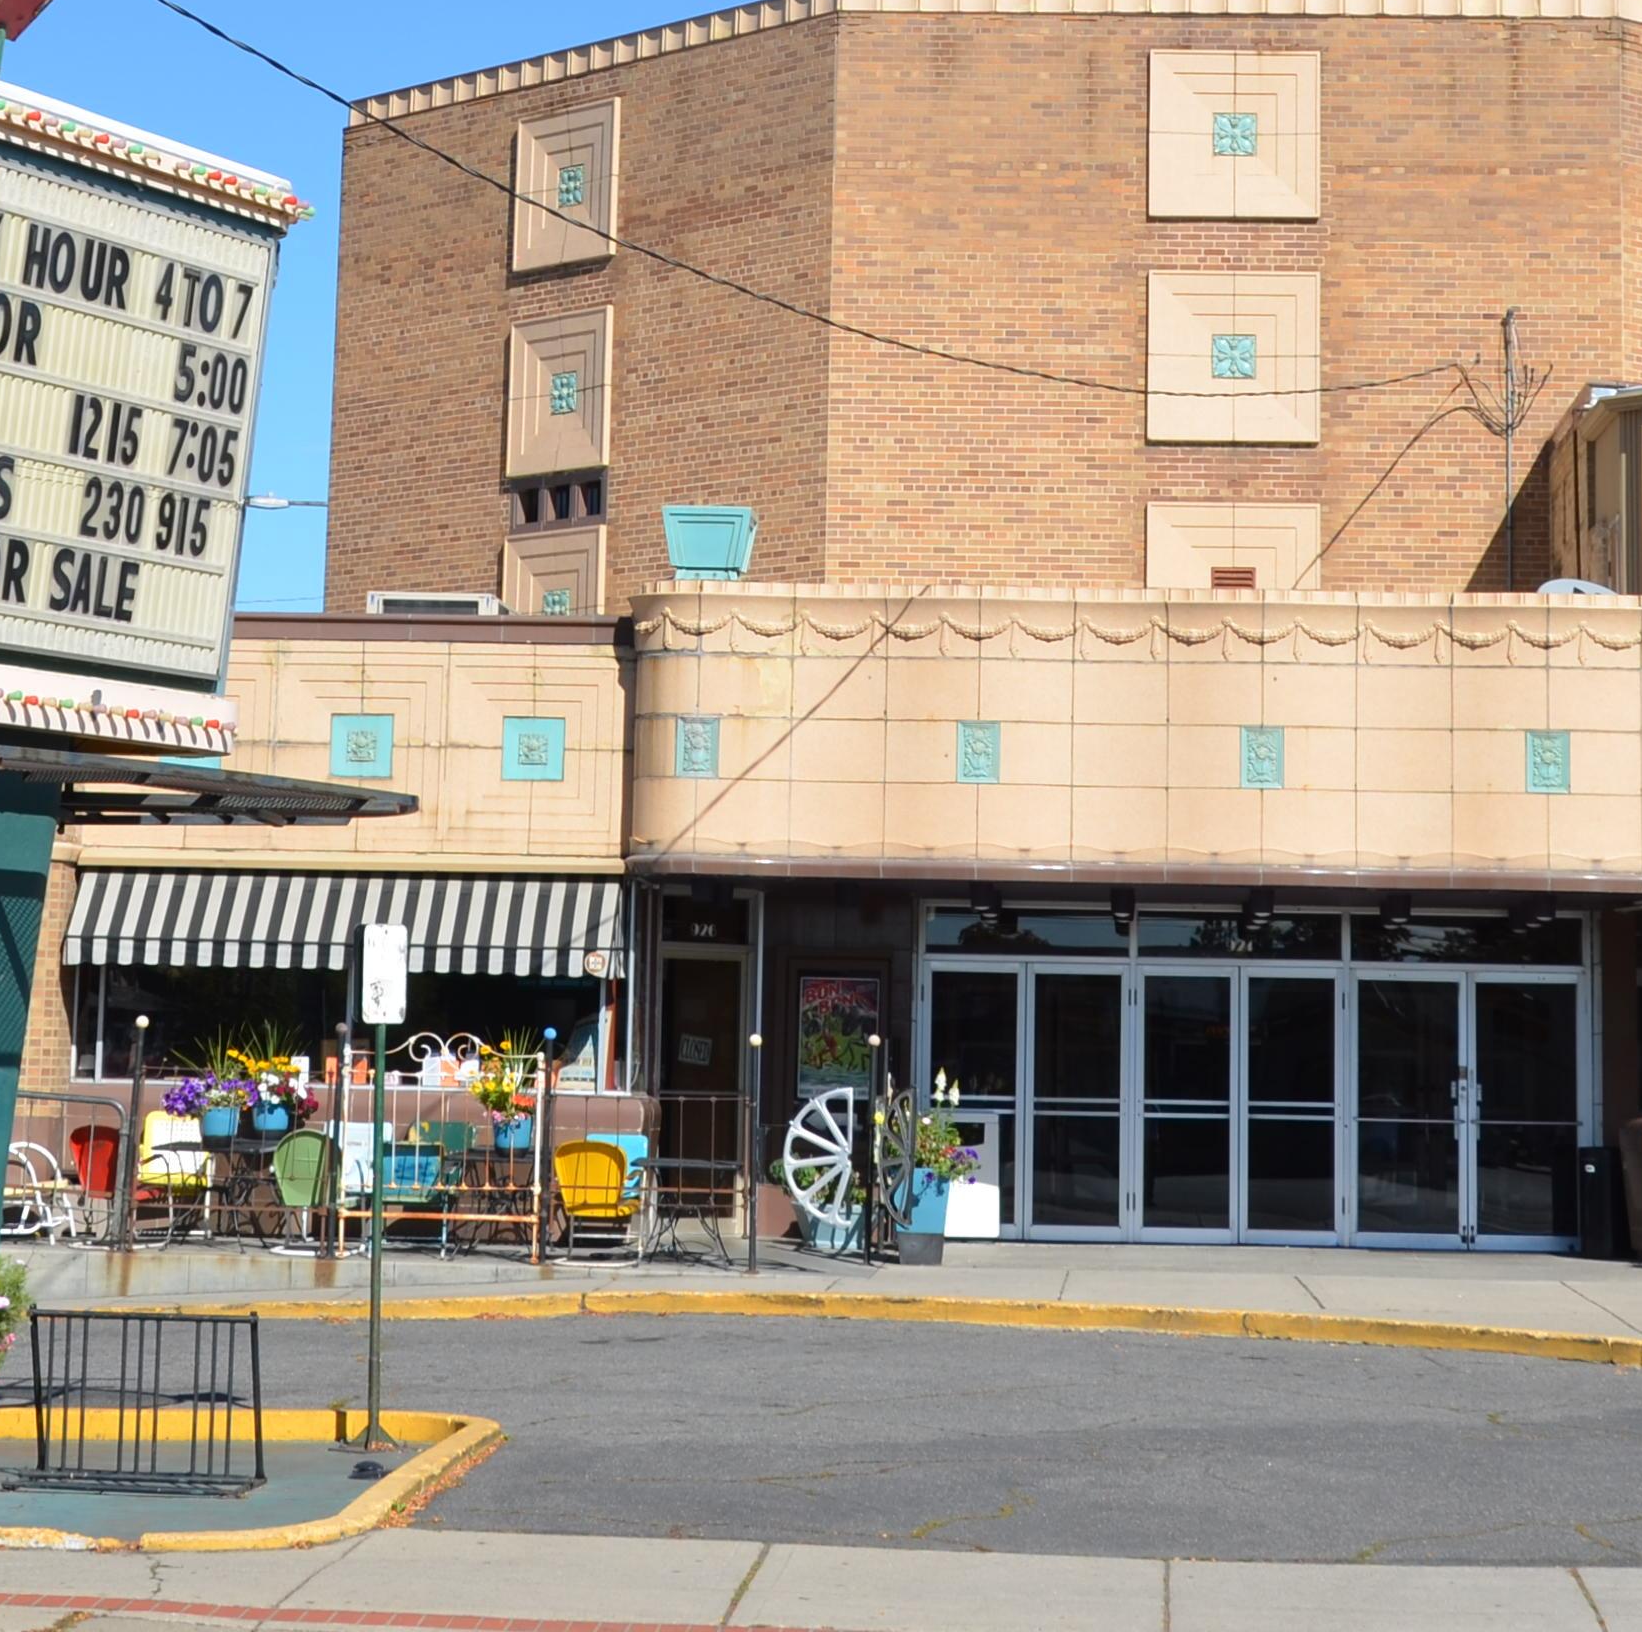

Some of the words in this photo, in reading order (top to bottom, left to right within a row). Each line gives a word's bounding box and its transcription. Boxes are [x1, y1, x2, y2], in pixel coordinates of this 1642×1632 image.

[22, 224, 130, 309] HOUR
[231, 284, 254, 340] 7
[174, 344, 248, 414] 5:00
[168, 418, 240, 487] 7:05
[80, 476, 144, 544] 230
[156, 493, 211, 557] 915
[49, 548, 140, 623] SALE
